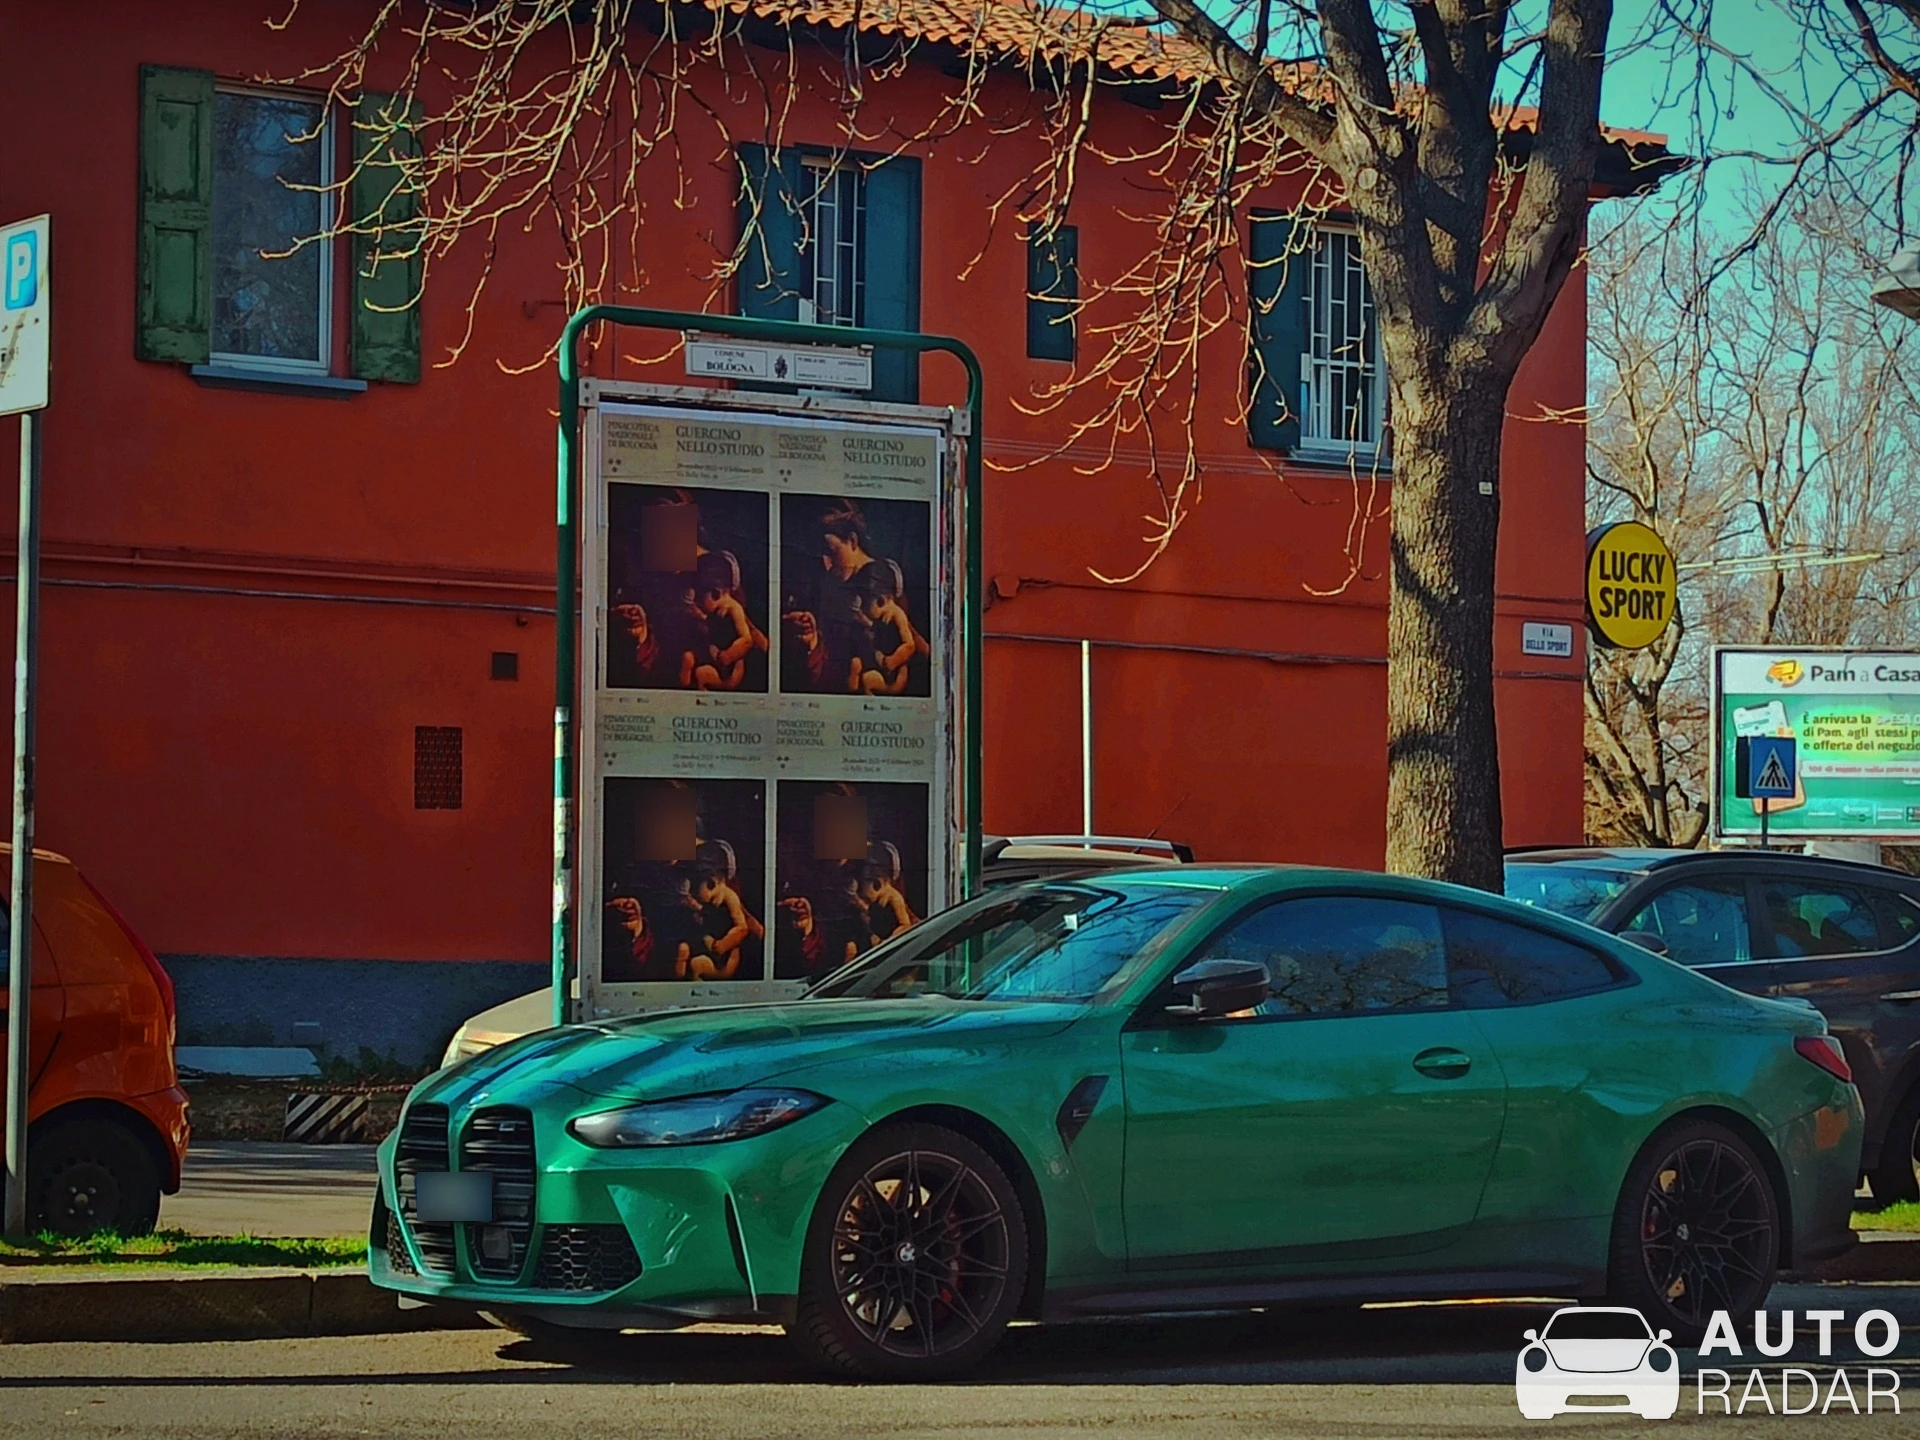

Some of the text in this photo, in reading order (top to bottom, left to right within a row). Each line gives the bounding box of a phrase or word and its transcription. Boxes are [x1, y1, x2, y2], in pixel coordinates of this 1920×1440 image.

[10, 241, 32, 301] P
[714, 350, 745, 358] COMUNE
[706, 361, 755, 374] BOLOGNA
[607, 421, 660, 433] PINACOTECA
[676, 425, 741, 441] GUERCINO
[608, 431, 653, 441] NAZIONALE
[778, 433, 827, 444] PINACOTECA
[608, 439, 658, 450] DI BOLOGNA
[676, 440, 765, 457] NELLO STUDIO
[778, 442, 822, 452] NAZIONALE
[843, 437, 904, 453] GUERCINO
[779, 451, 826, 461] DI BOLOGNA
[843, 452, 926, 468] NELLO STUDIO
[1599, 550, 1666, 584] LUCKY
[1599, 586, 1666, 621] SPORT
[1542, 627, 1554, 637] VIA
[1525, 639, 1568, 652] DELLO SPORT
[1811, 664, 1920, 682] Pam a Casa
[604, 714, 656, 724] PINACOTECA
[672, 716, 738, 730] GUERCINO
[776, 719, 825, 729] PINACOTECA
[1813, 713, 1858, 724] arrivata
[1861, 714, 1872, 724] la
[604, 723, 650, 733] NAZIONALE
[777, 728, 820, 737] NAZIONALE
[841, 720, 903, 734] GUERCINO
[1803, 727, 1814, 737] di
[1847, 727, 1869, 740] agli
[1875, 726, 1908, 737] stessi
[604, 732, 654, 742] DI BOLOGNA
[672, 731, 762, 745] NELLO STUDIO
[777, 737, 824, 746] DI BOLOGNA
[841, 735, 925, 749] NELLO STUDIO
[1803, 740, 1920, 753] e offerte del negozio
